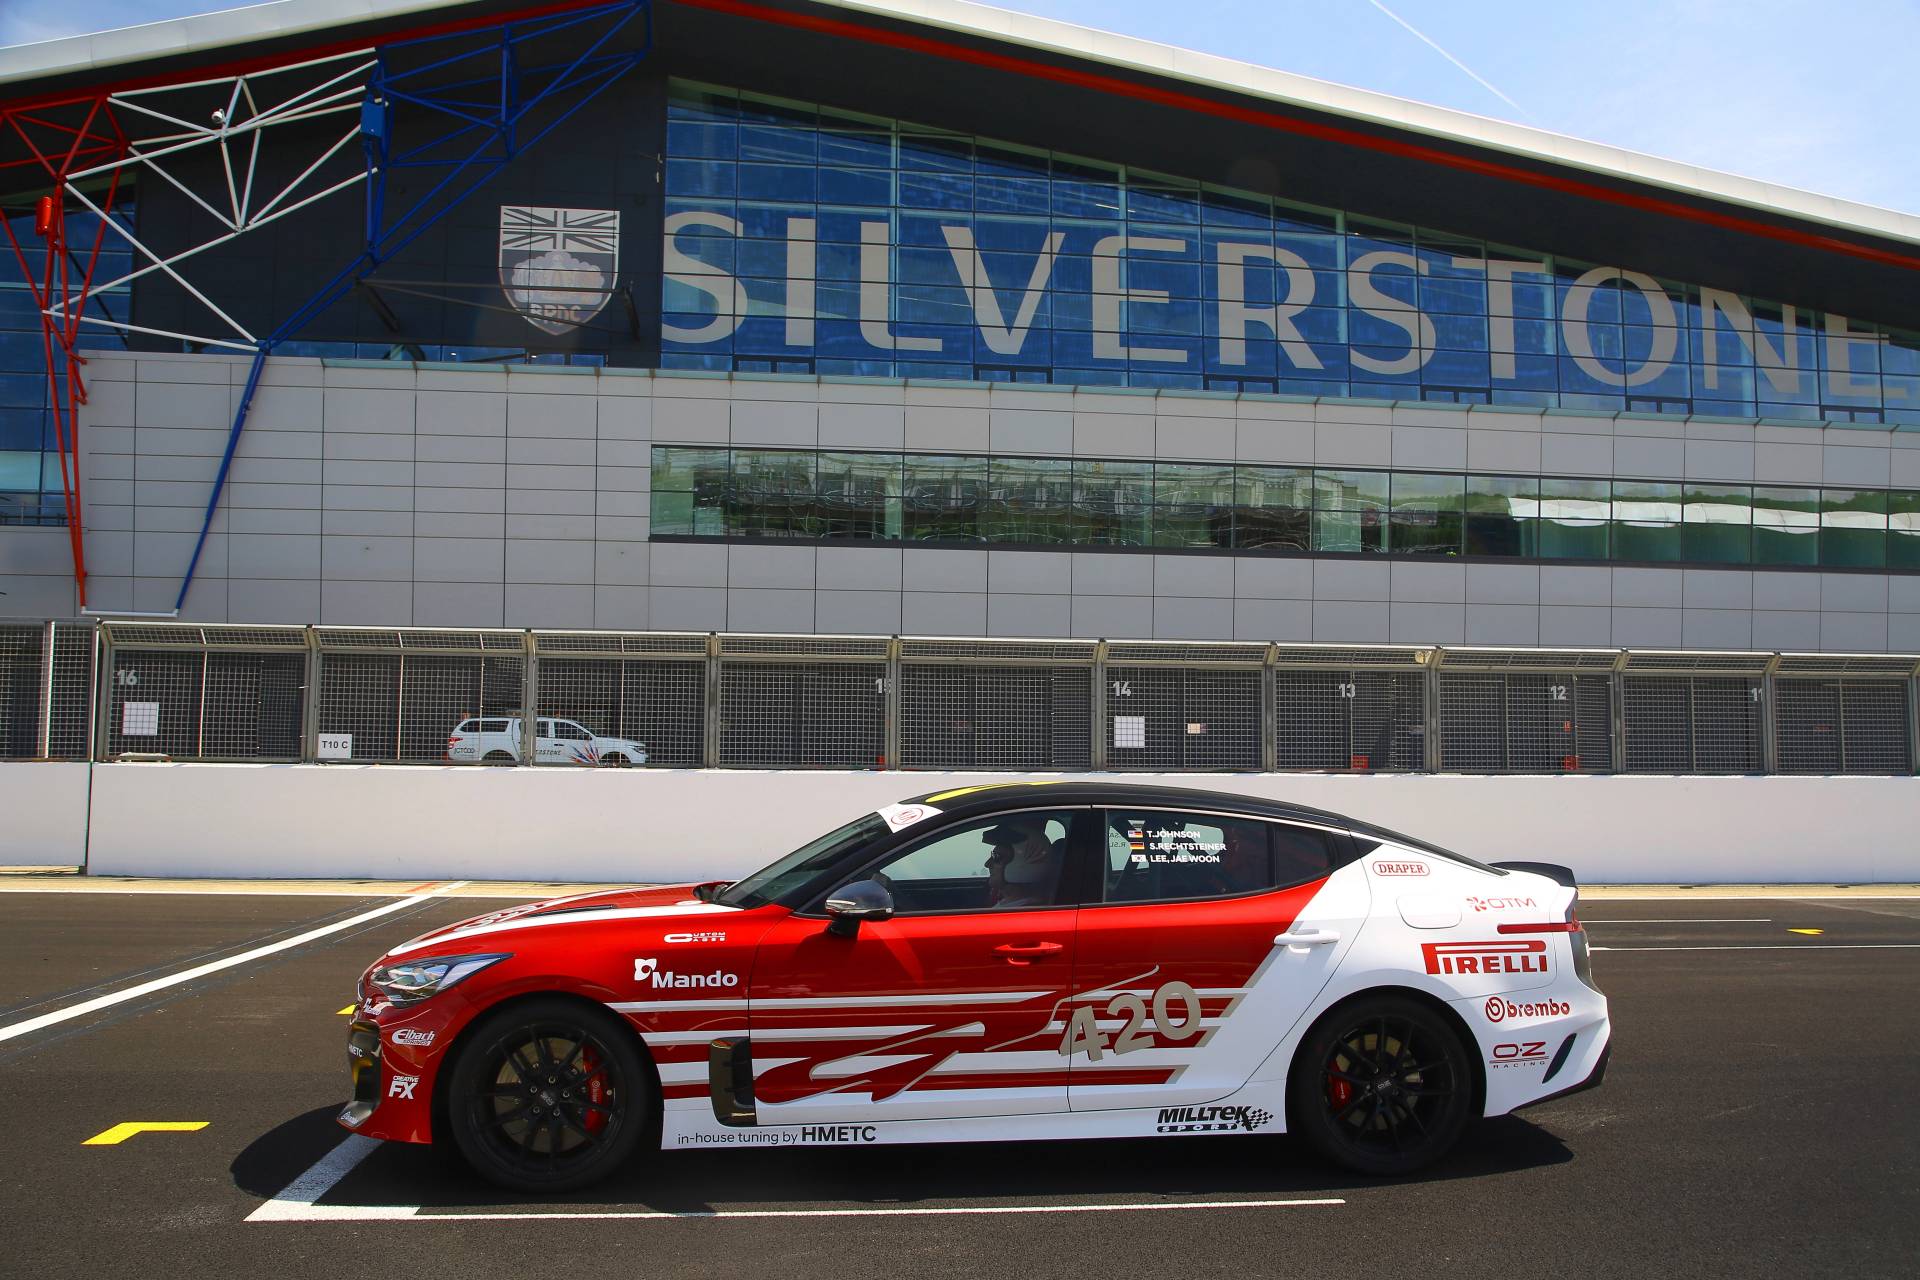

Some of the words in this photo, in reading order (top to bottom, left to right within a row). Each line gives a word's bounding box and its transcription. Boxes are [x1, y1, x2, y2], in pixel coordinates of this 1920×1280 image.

[660, 211, 1906, 399] SILVERSTONE
[117, 669, 138, 686] 16
[1112, 680, 1132, 697] 14
[1338, 683, 1356, 698] 13
[1550, 685, 1567, 700] 12
[322, 740, 339, 749] T10
[341, 740, 348, 749] C
[1146, 830, 1201, 838] T.JOHNSON
[1149, 842, 1227, 851] S.RECHTSTEINER
[1189, 855, 1220, 863] WOON
[1378, 862, 1425, 875] DRAPER
[1487, 898, 1537, 908] OTM
[1421, 941, 1548, 975] PIRELLI
[652, 970, 738, 988] Mando
[1506, 998, 1570, 1017] brembo
[1058, 980, 1202, 1062] 420
[1493, 1060, 1546, 1069] RACING
[388, 1081, 418, 1100] FX
[677, 1131, 735, 1144] in-house
[737, 1130, 779, 1145] tuning
[782, 1130, 798, 1144] by
[801, 1125, 877, 1142] HMETC
[1161, 1122, 1236, 1133] SPORT
